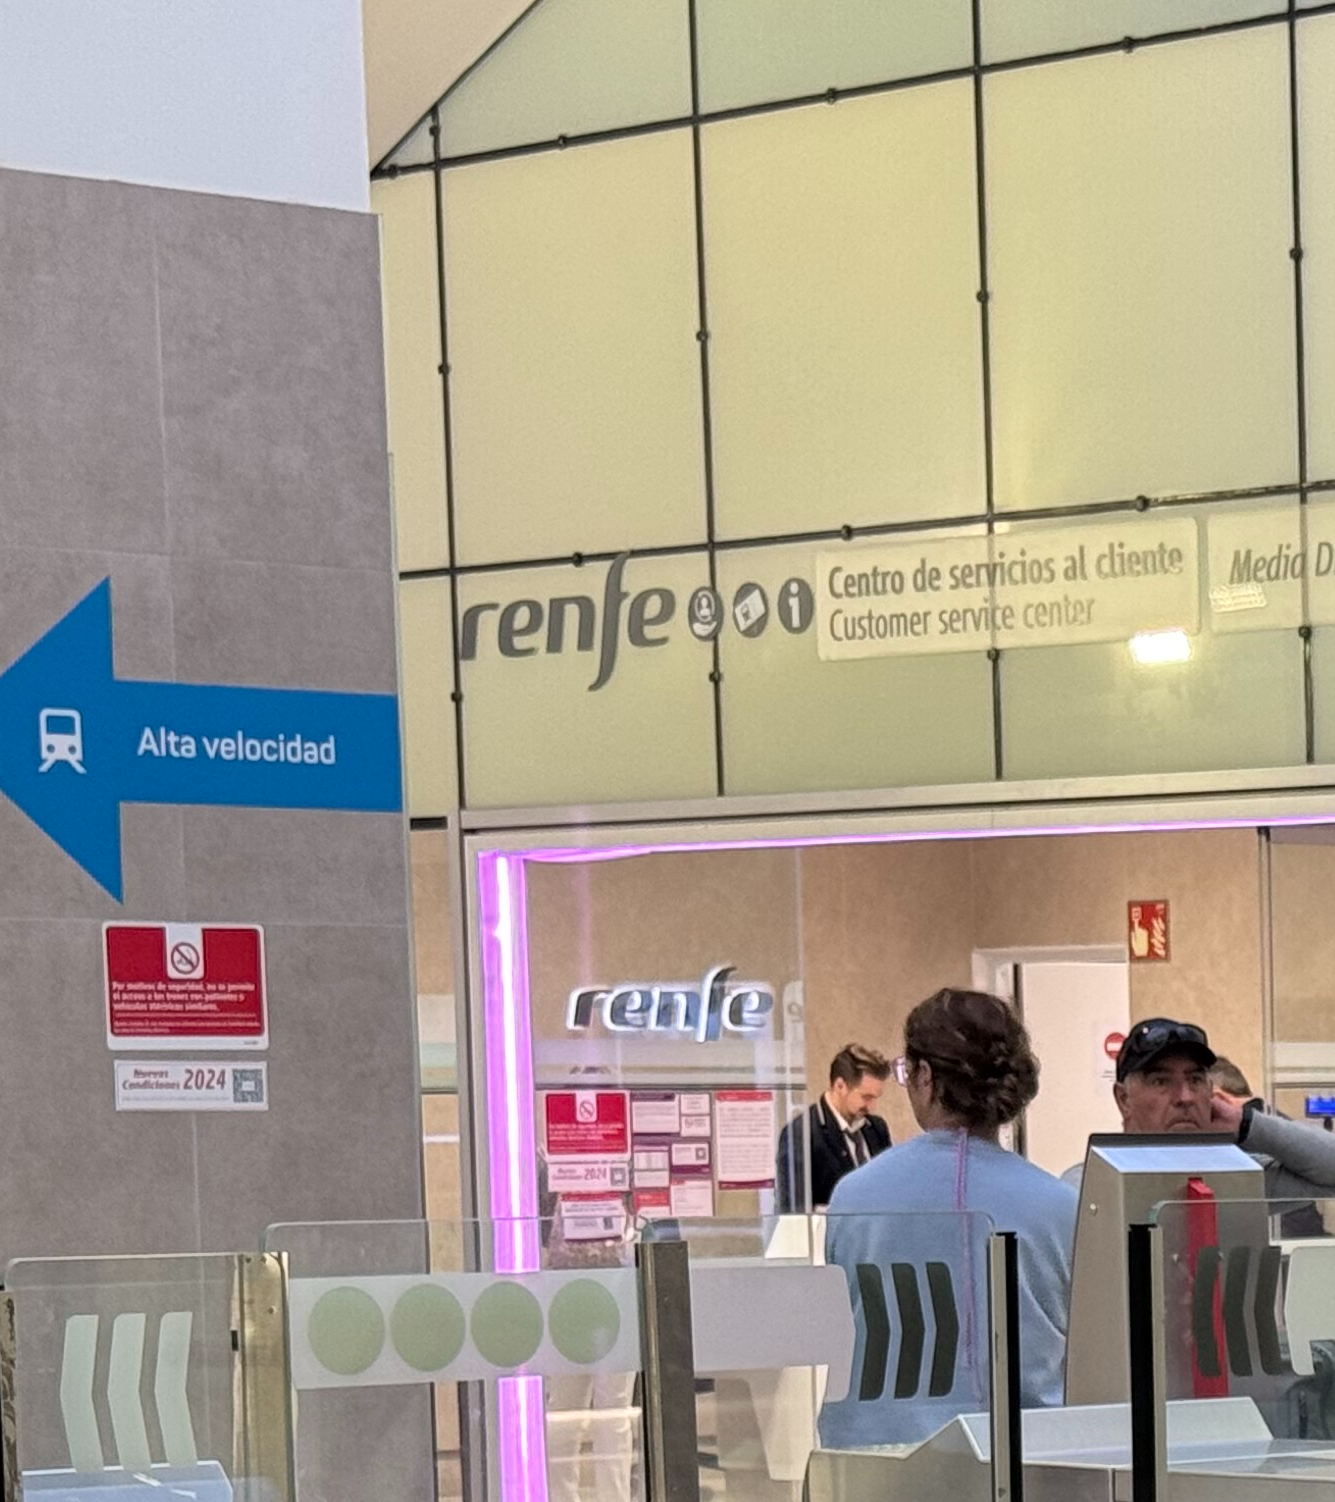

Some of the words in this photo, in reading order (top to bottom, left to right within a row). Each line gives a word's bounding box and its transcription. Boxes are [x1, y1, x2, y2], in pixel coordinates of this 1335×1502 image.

[829, 565, 904, 600] Centro
[912, 558, 940, 592] de
[949, 548, 1055, 590] servicios
[1063, 545, 1088, 582] al
[1096, 542, 1184, 580] cliente
[459, 551, 676, 692] renfe
[829, 608, 931, 642] Customer
[939, 597, 1015, 635] service
[1023, 595, 1095, 630] center
[137, 726, 197, 759] Alta
[202, 730, 336, 765] velocidad
[565, 963, 774, 1043] renfe
[183, 1068, 226, 1090] 2024
